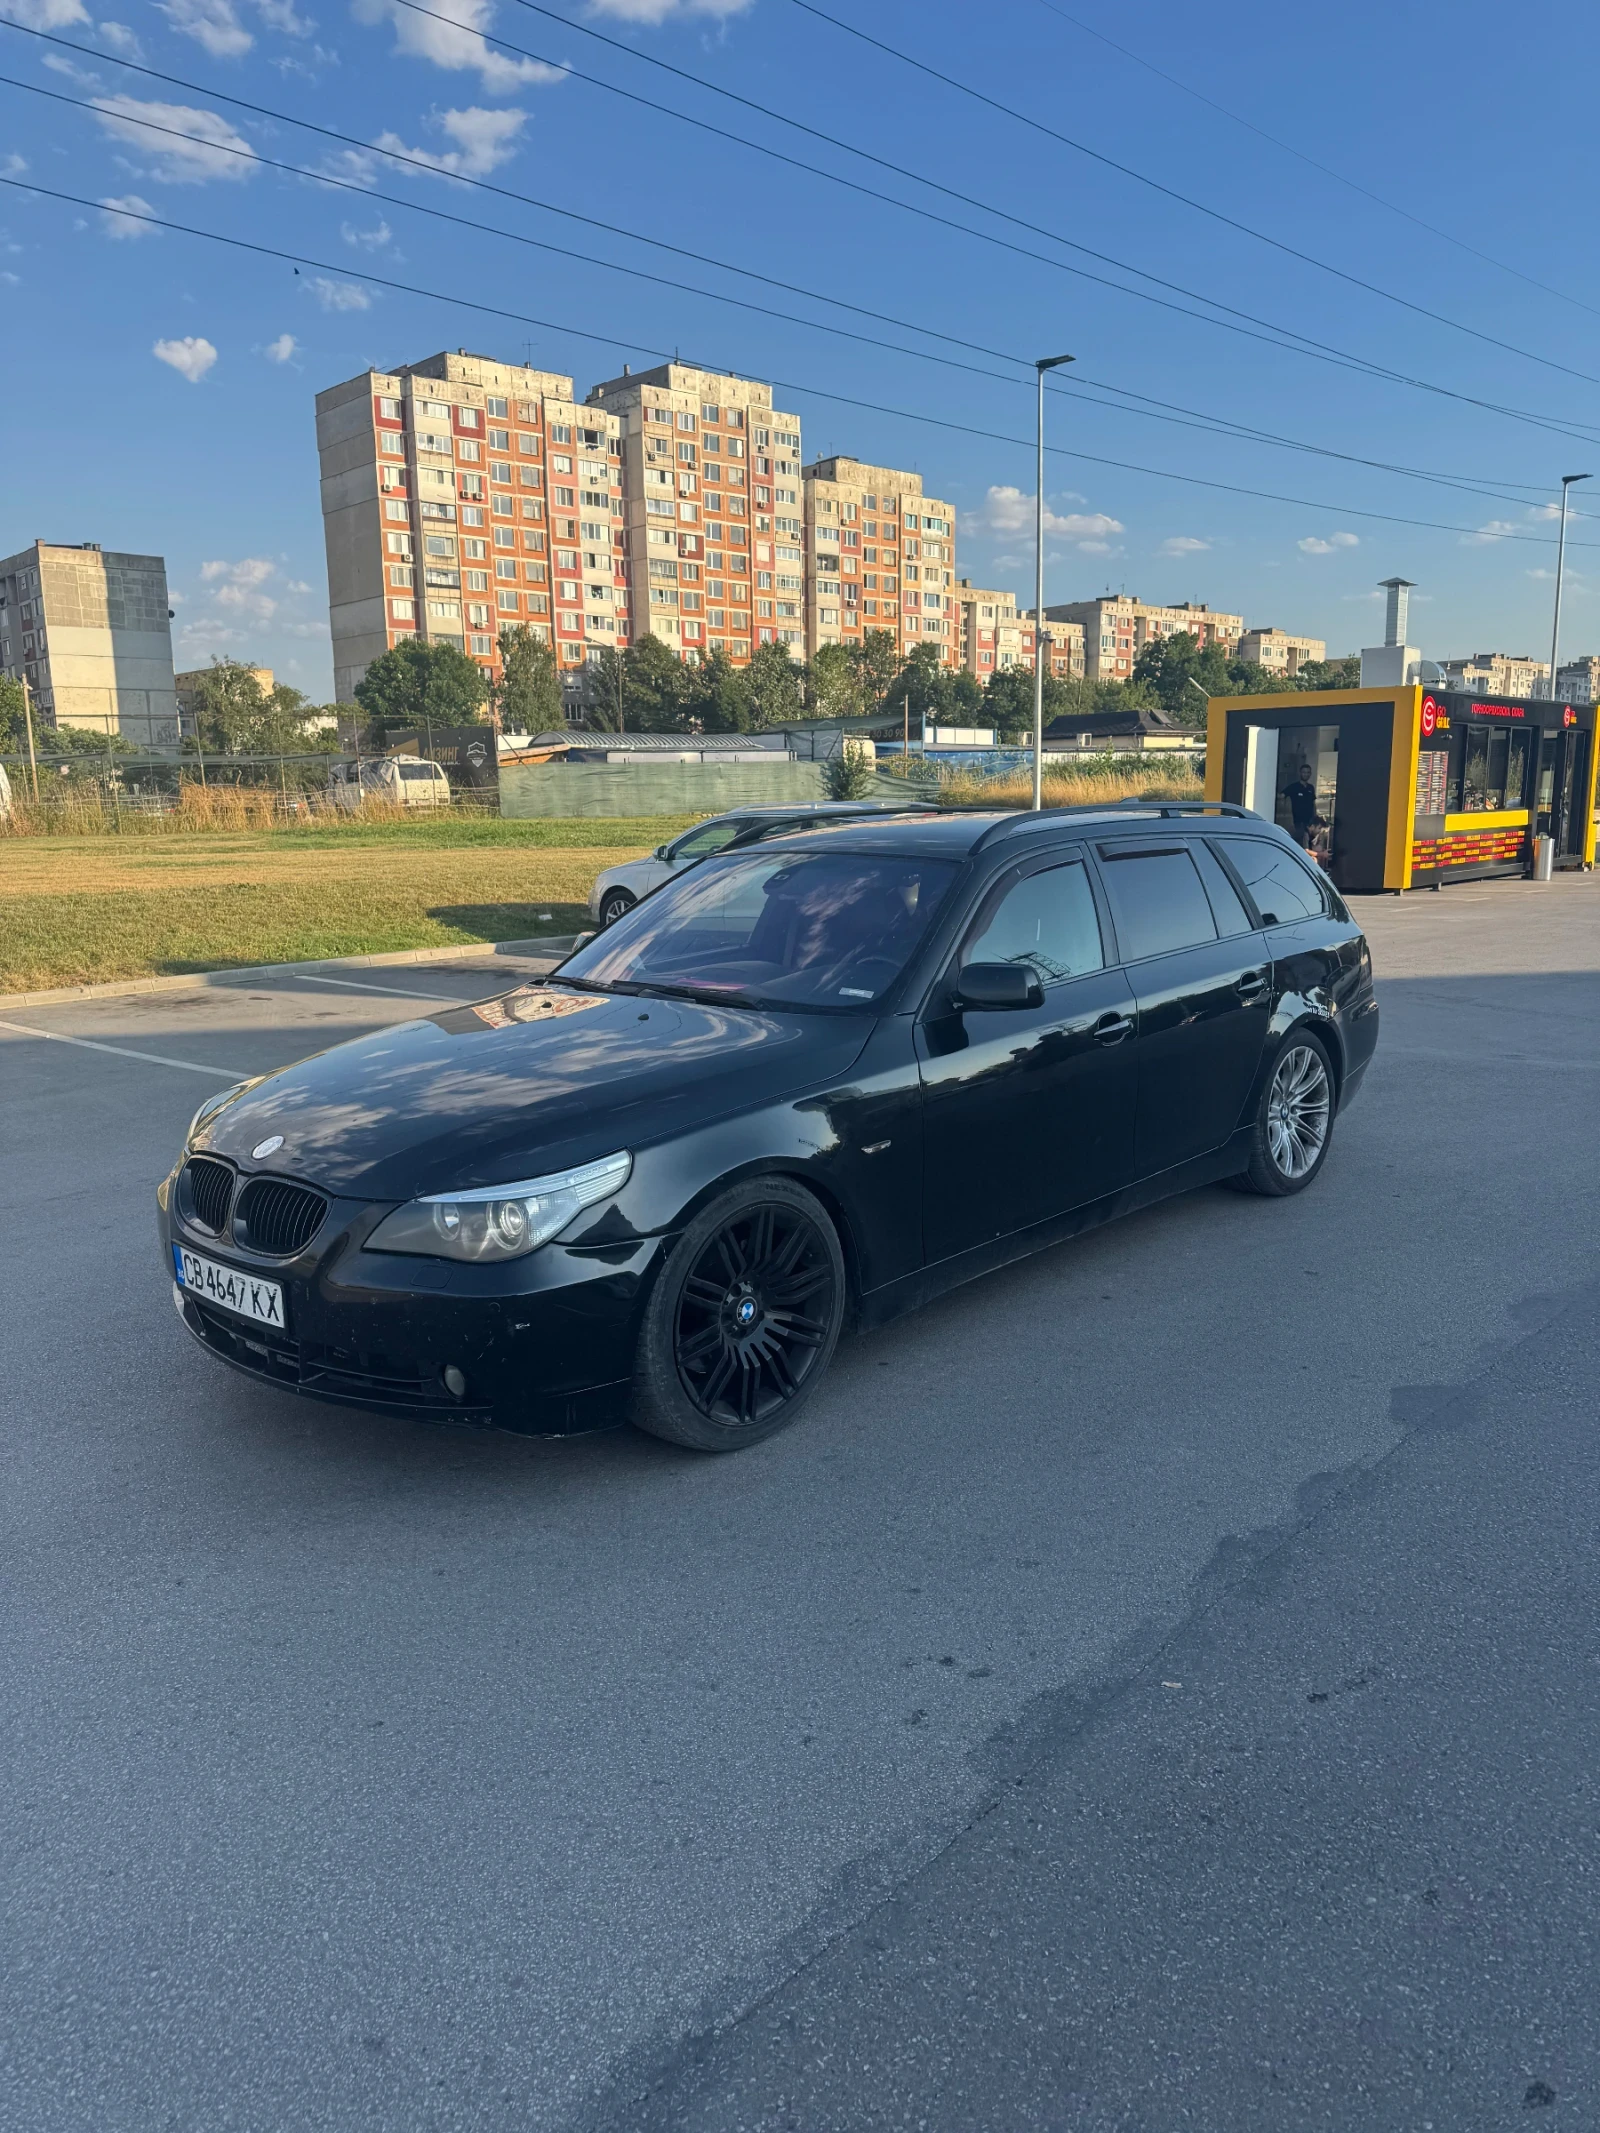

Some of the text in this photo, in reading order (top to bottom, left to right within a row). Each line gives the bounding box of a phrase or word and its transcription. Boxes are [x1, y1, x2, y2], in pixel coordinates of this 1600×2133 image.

[183, 1253, 280, 1322] CB 4647 KX
